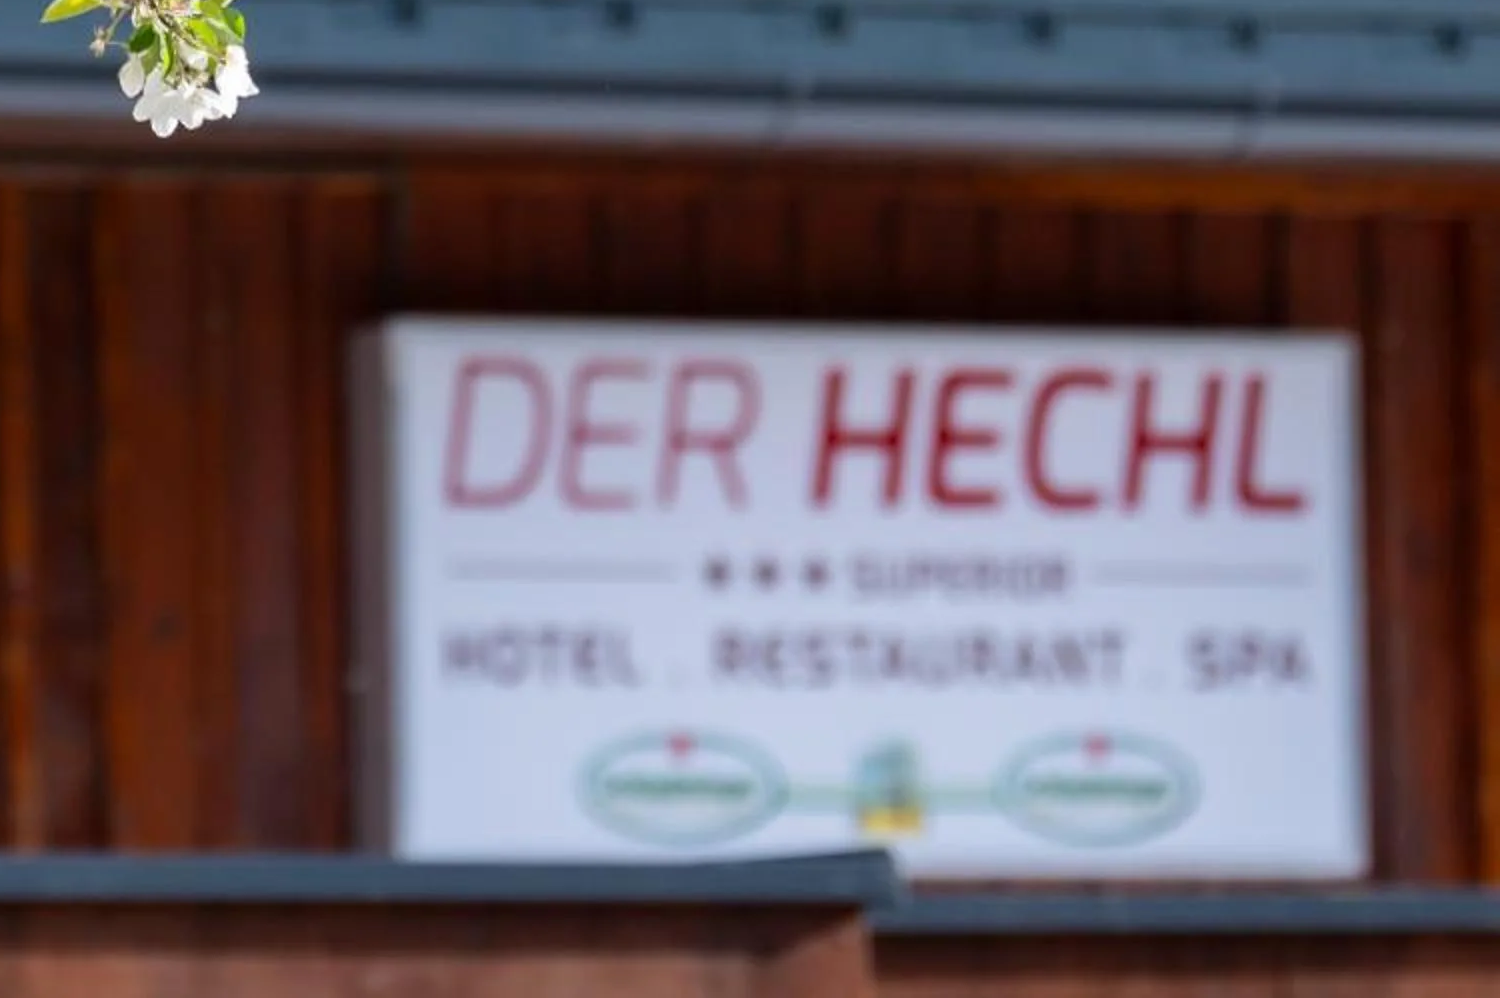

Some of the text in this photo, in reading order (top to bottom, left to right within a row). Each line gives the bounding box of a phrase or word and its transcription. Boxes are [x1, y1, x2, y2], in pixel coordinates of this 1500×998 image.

[441, 354, 1312, 516] DER HECHL
[846, 554, 1073, 600] SUPERIOR
[438, 624, 1314, 692] HOTEL RESTAURANT SPA
